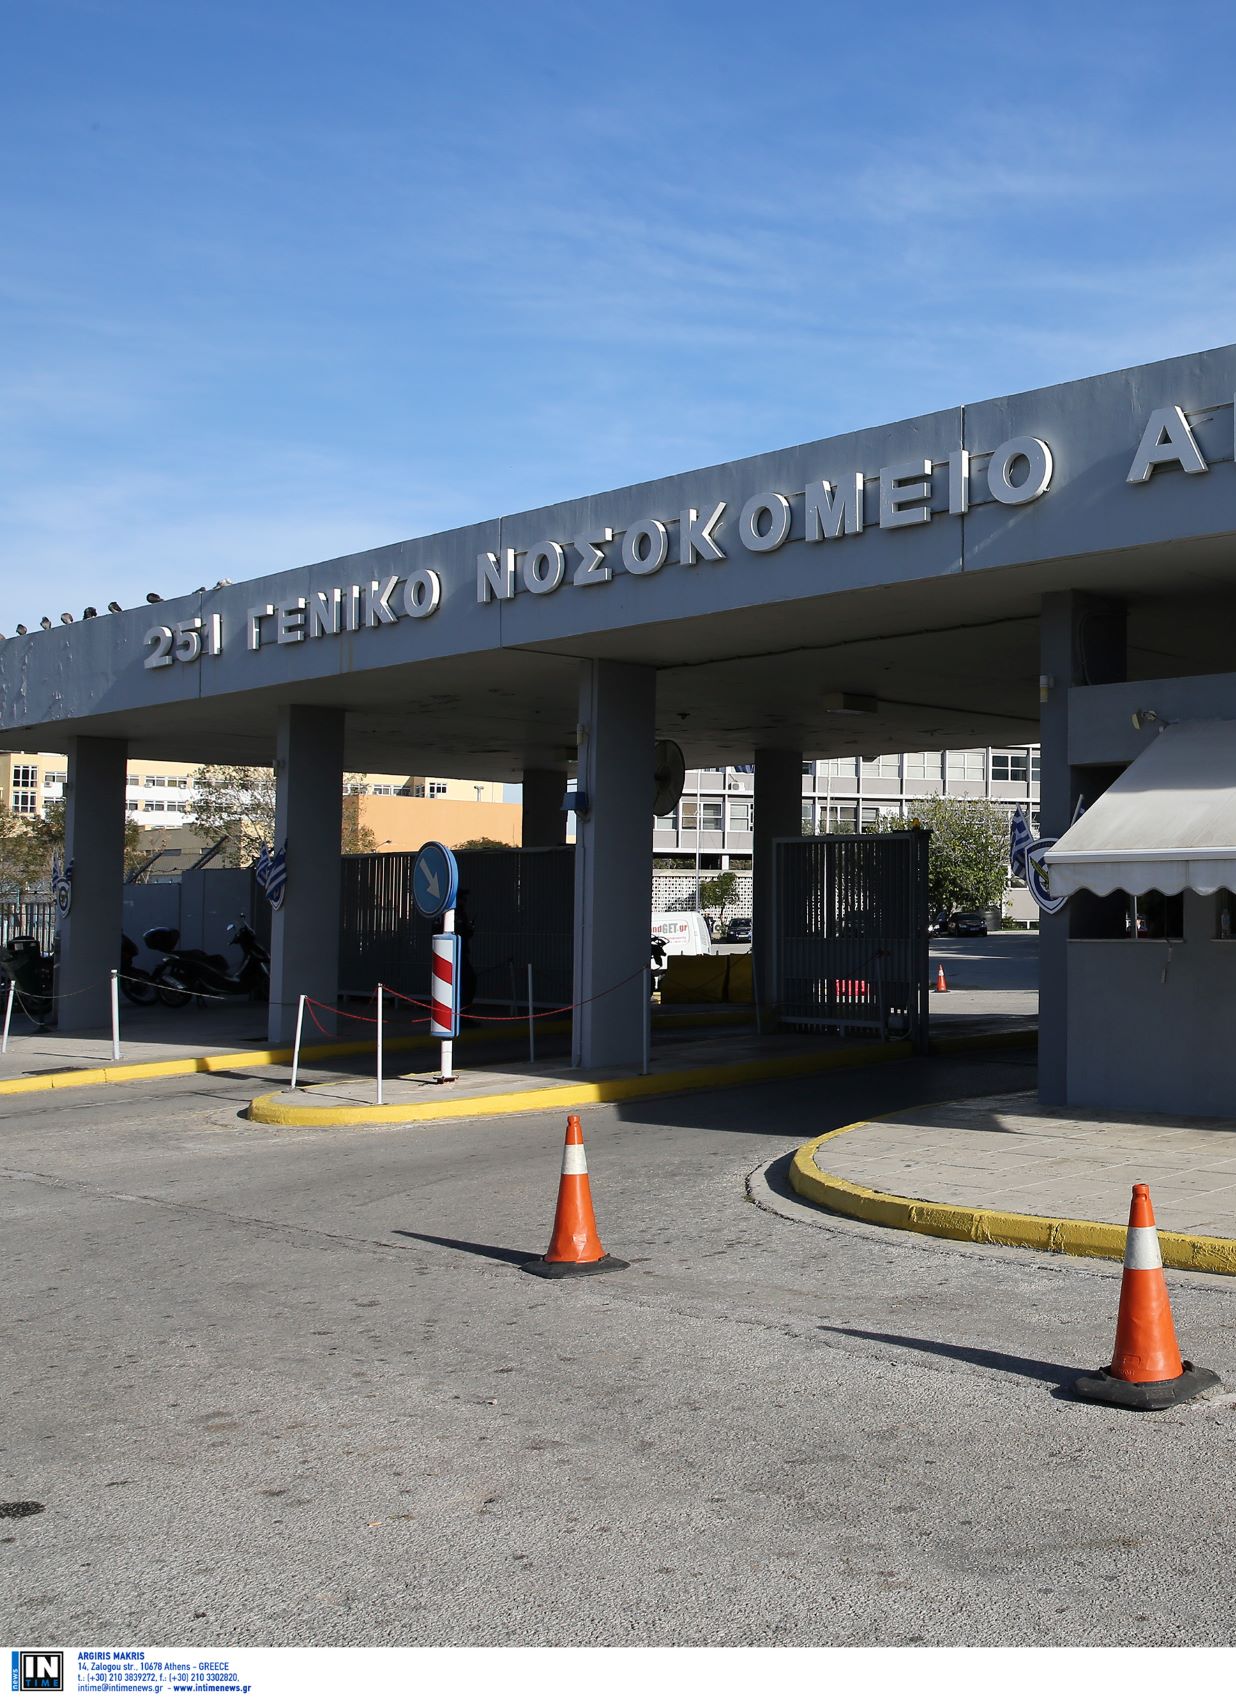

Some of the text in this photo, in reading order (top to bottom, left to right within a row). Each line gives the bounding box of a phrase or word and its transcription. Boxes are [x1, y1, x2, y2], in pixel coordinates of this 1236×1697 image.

[143, 613, 223, 669] 251
[247, 568, 441, 651] ΓΕΝΙΚΟ
[476, 435, 1054, 603] ΝΟΣΟΚΟΜΕΙΟ
